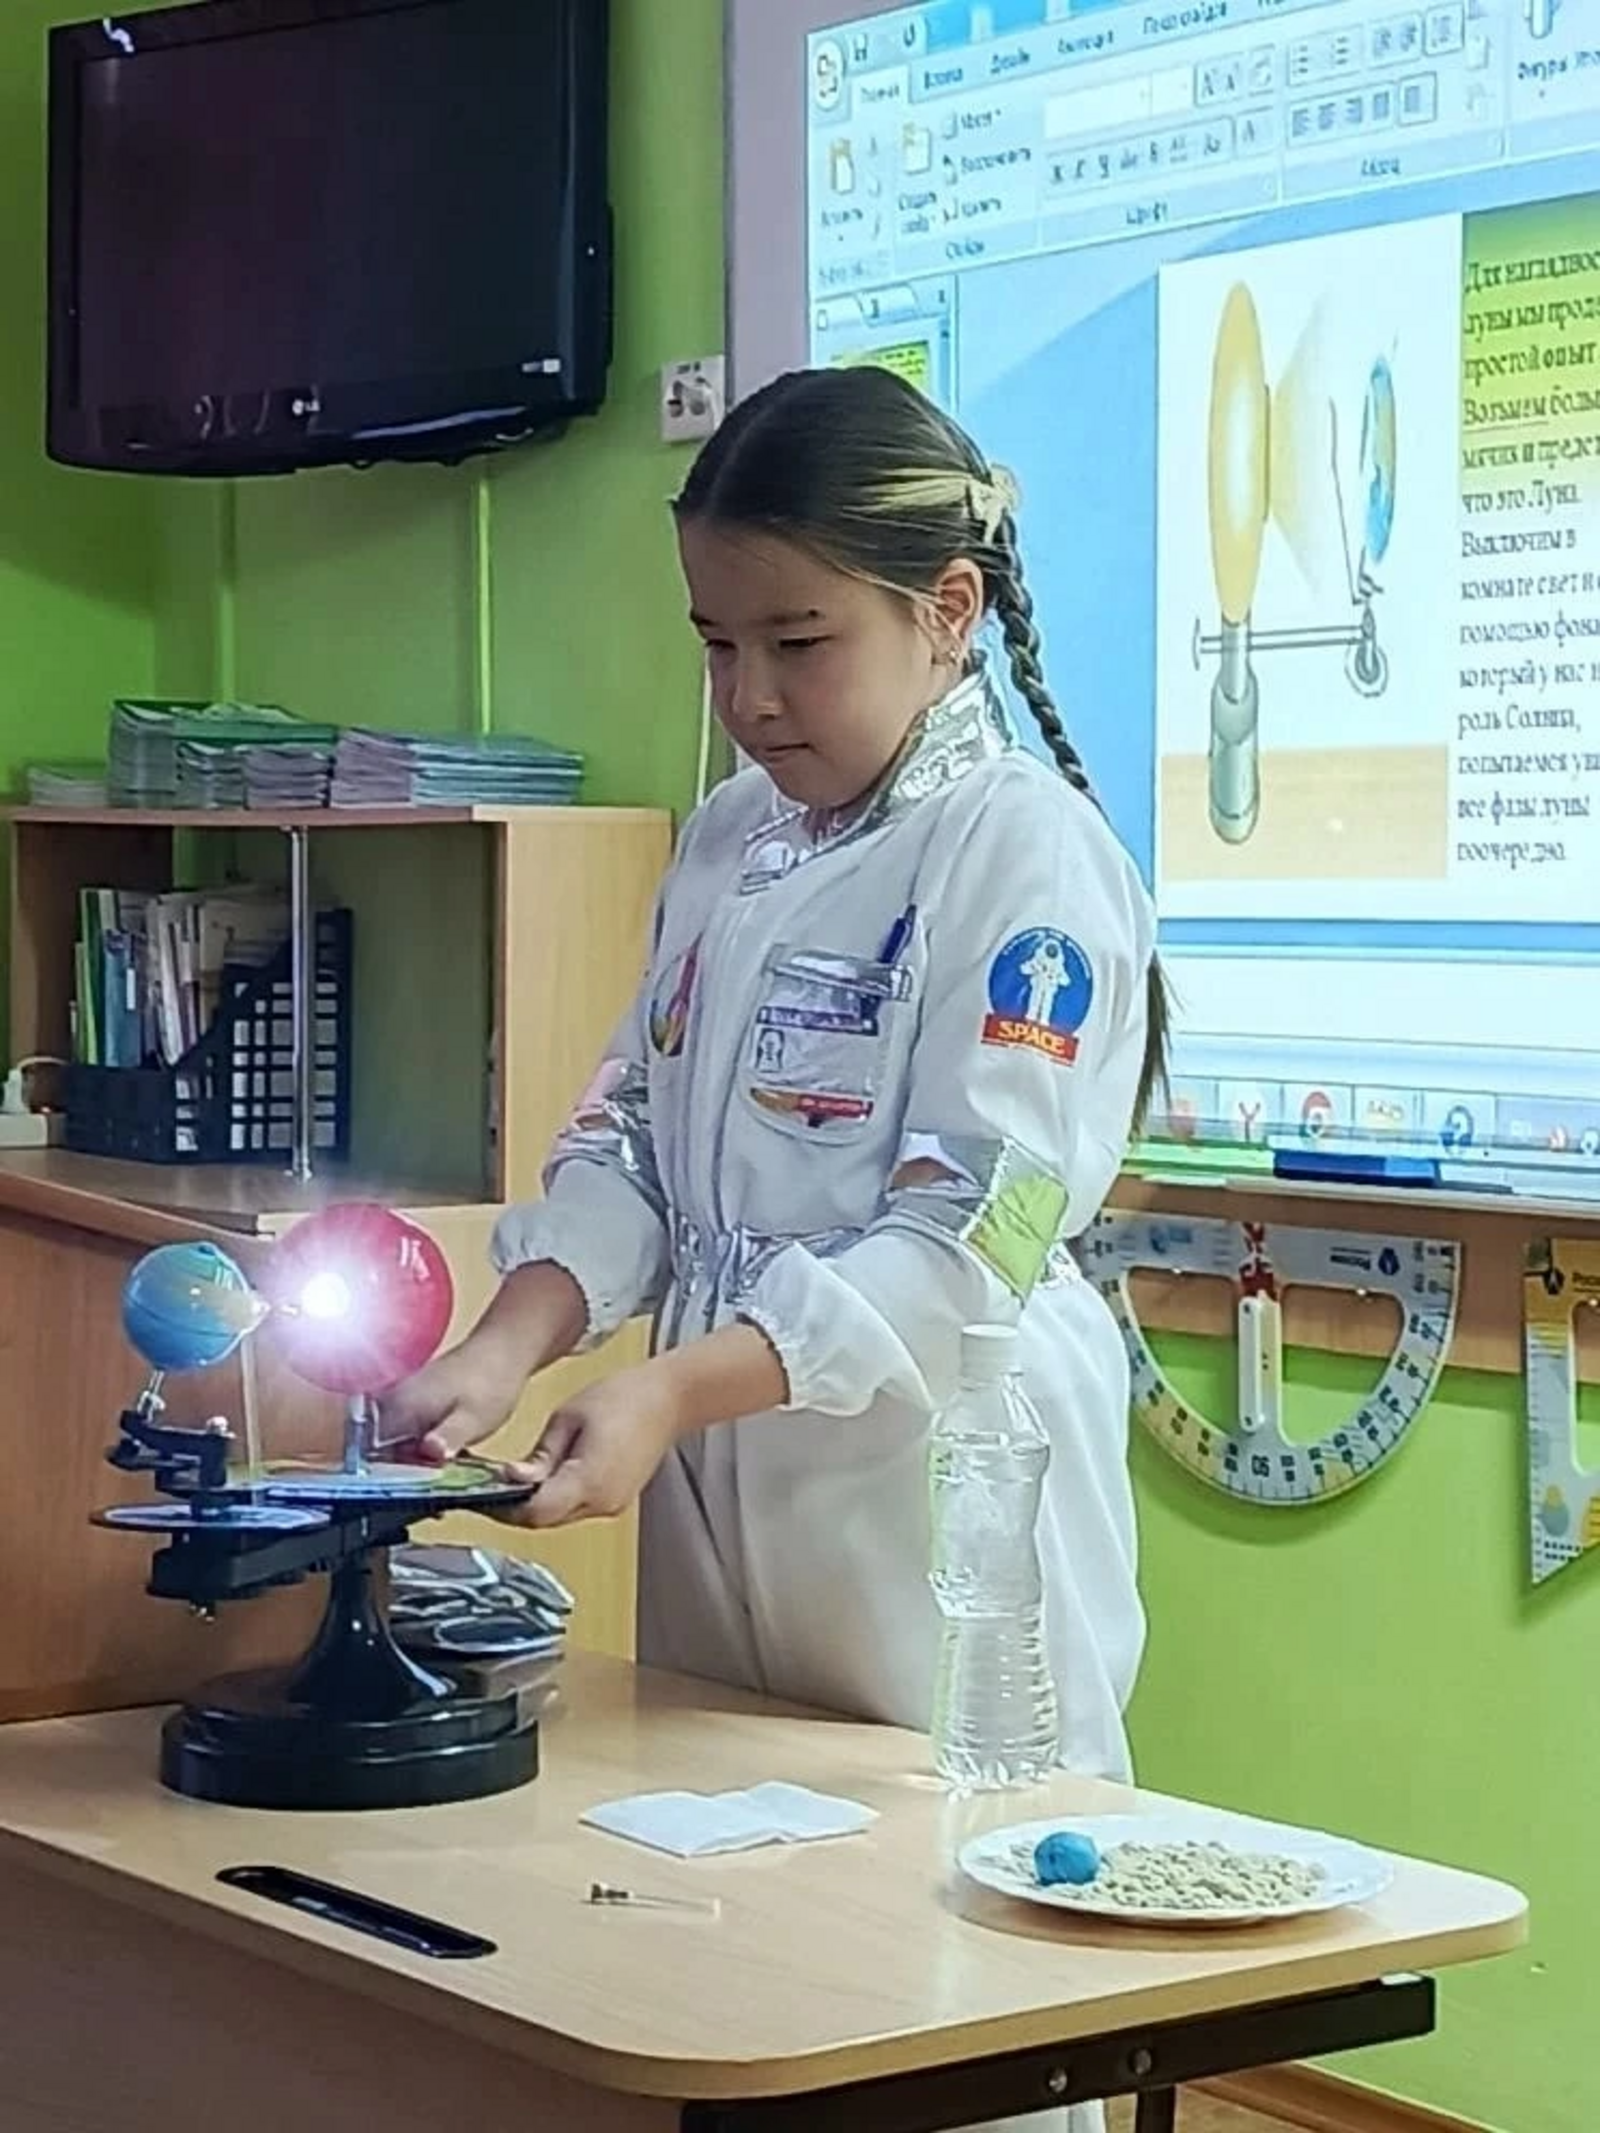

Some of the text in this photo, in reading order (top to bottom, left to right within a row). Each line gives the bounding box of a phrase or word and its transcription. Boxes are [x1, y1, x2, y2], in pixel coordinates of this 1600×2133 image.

[1464, 341, 1597, 387] простой опыт
[1461, 491, 1494, 514] что
[1496, 488, 1526, 511] это
[1461, 528, 1577, 558] Выключим в
[1460, 576, 1534, 600] комнате
[1537, 573, 1579, 595] свет
[1459, 619, 1551, 646] помощью
[1459, 659, 1536, 696] который
[1538, 665, 1549, 694] у
[1553, 662, 1587, 684] нас
[1457, 709, 1503, 741] роль
[1457, 753, 1569, 776] попытаемся
[1457, 798, 1487, 819] все
[1490, 790, 1537, 827] фазы
[997, 1019, 1068, 1056] SPACE
